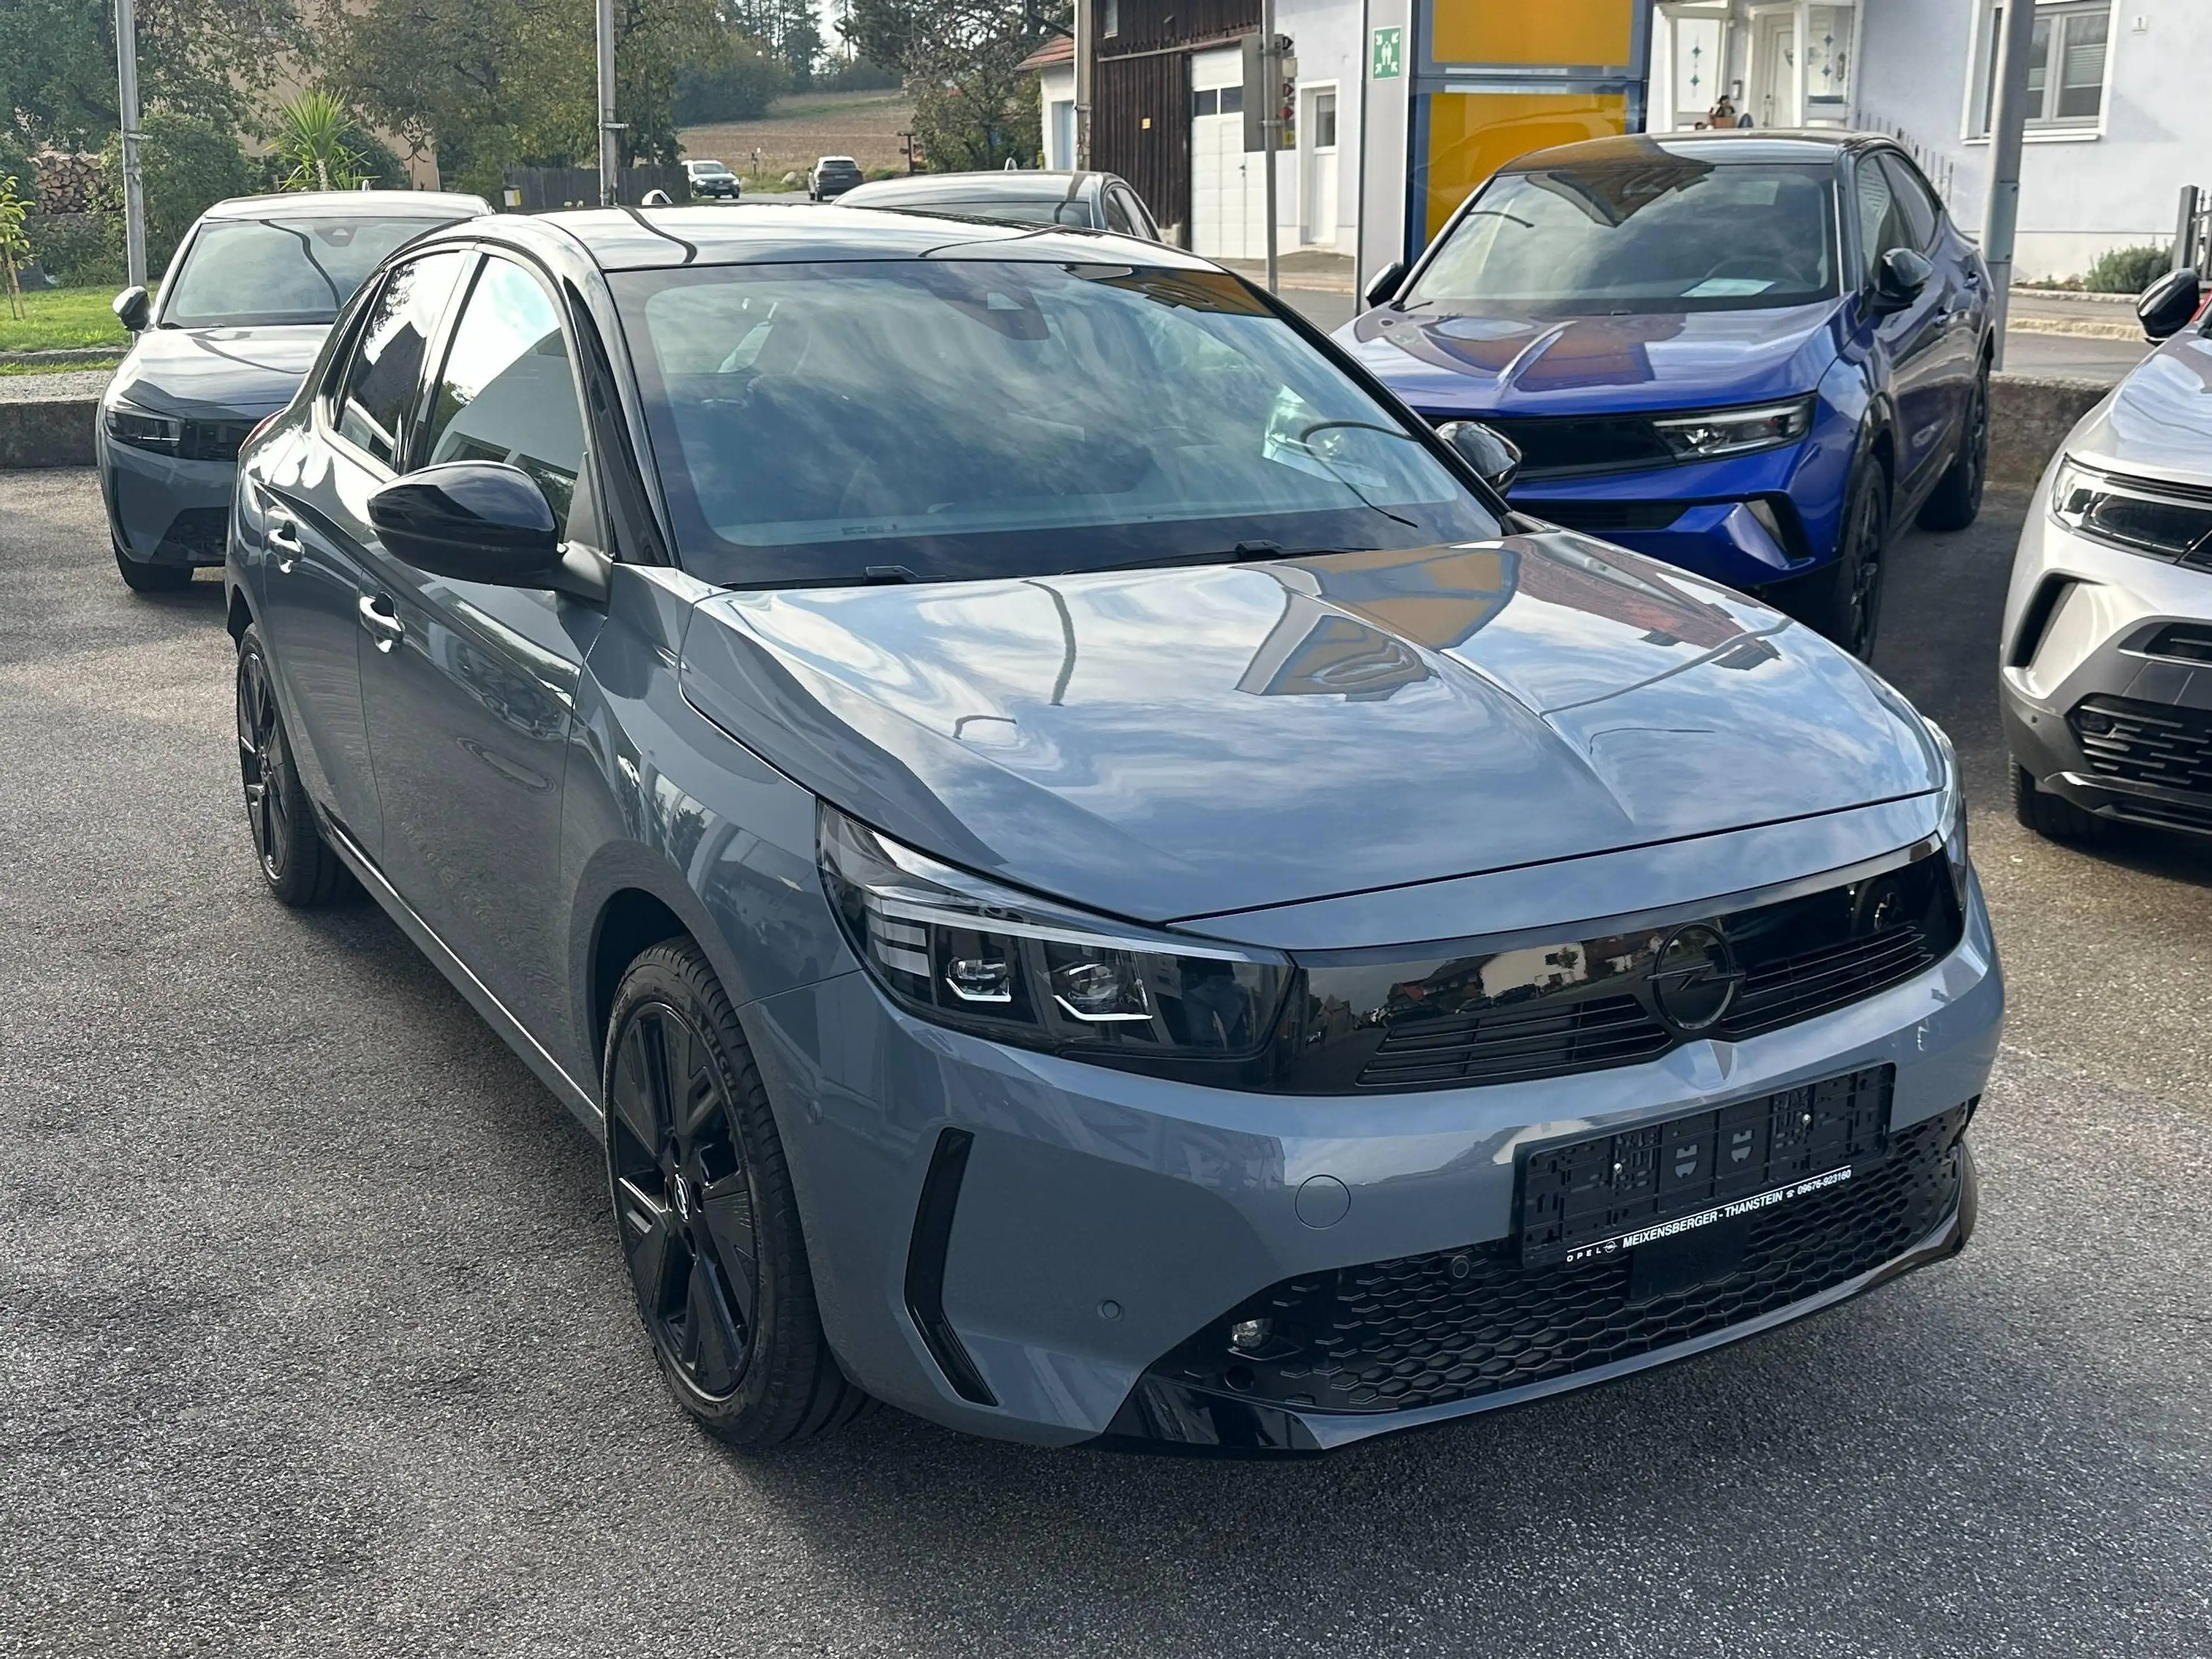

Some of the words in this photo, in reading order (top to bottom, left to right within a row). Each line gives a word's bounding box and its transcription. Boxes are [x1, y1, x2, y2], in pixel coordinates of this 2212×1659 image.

[1567, 1248, 1601, 1262] OPEL
[1623, 1211, 1717, 1248] MEIXENSBERGER
[1725, 1191, 1783, 1218] THANSTEIN
[1797, 1169, 1851, 1195] 09676-923160
